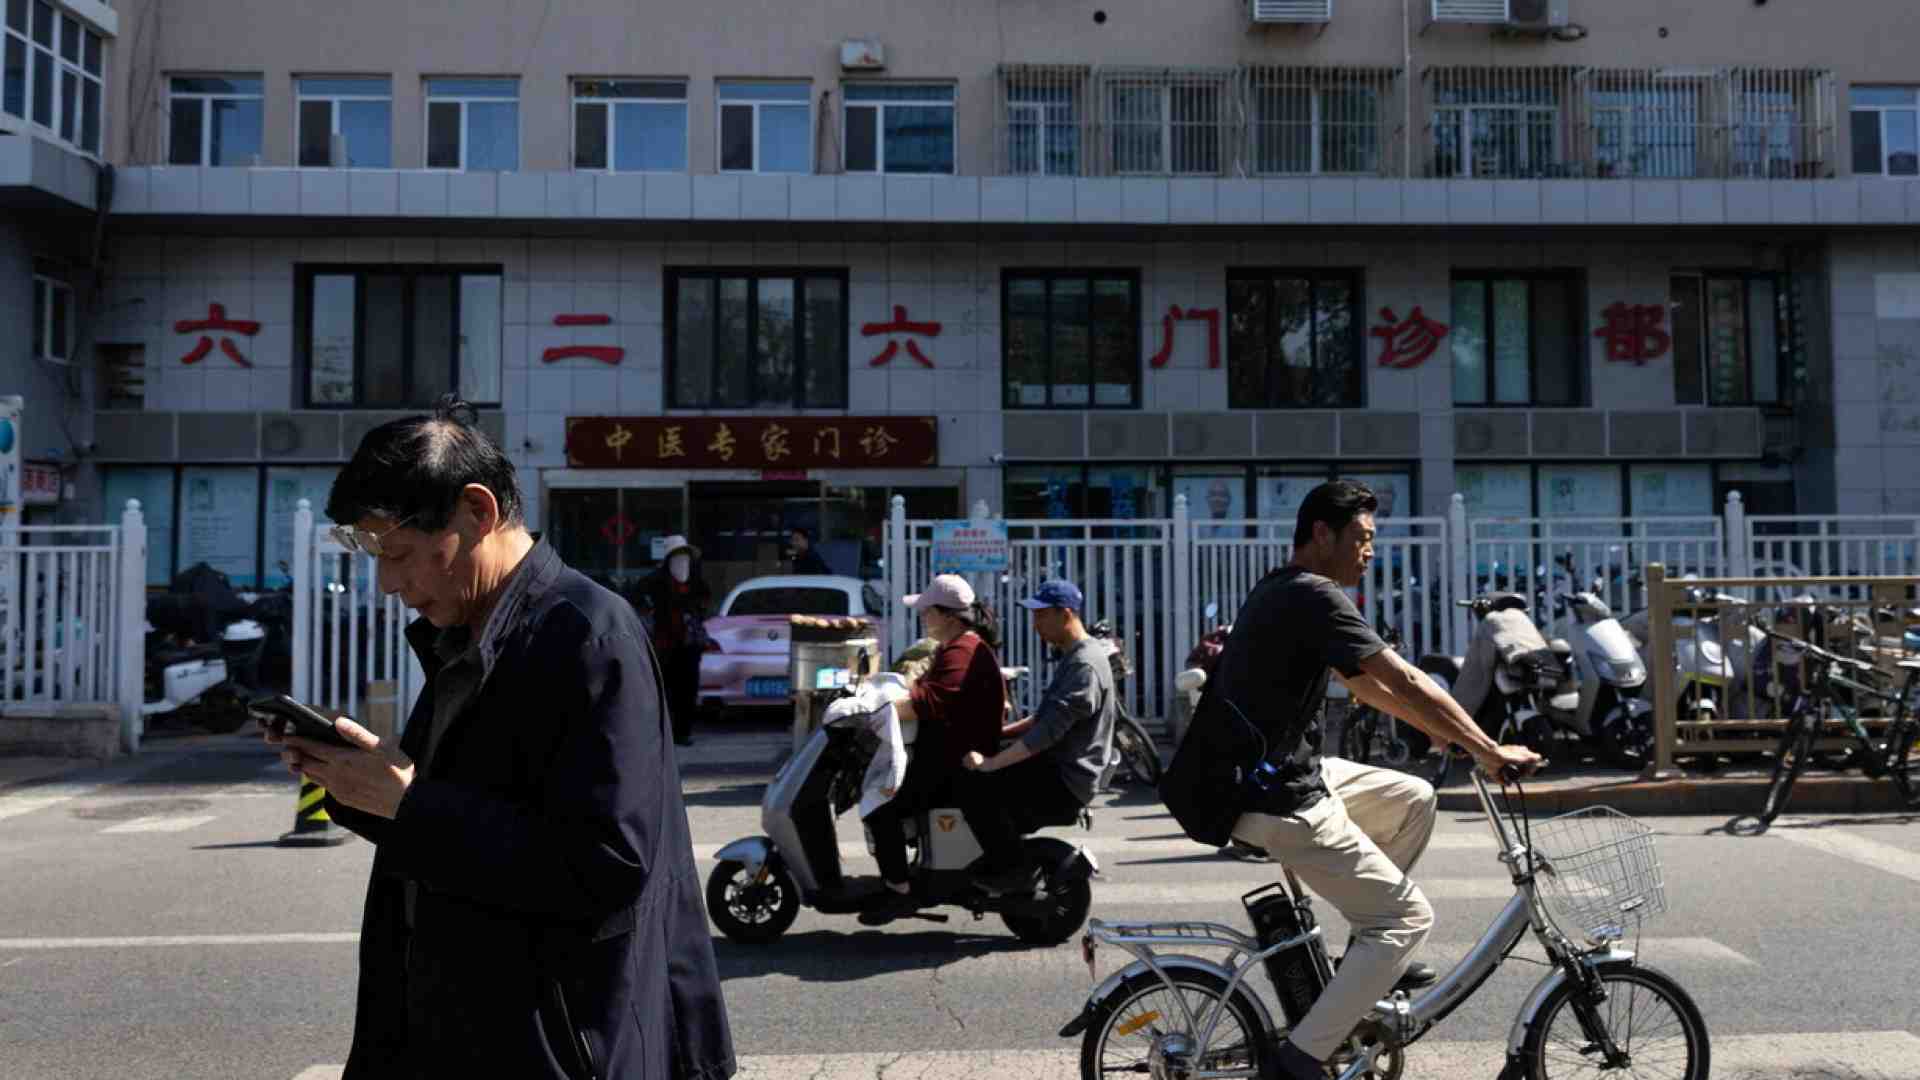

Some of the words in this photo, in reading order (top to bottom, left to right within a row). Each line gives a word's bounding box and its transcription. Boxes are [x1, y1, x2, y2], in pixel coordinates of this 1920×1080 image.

[174, 303, 1671, 366] 六二六门诊部
[605, 424, 898, 460] 中医专家门诊
